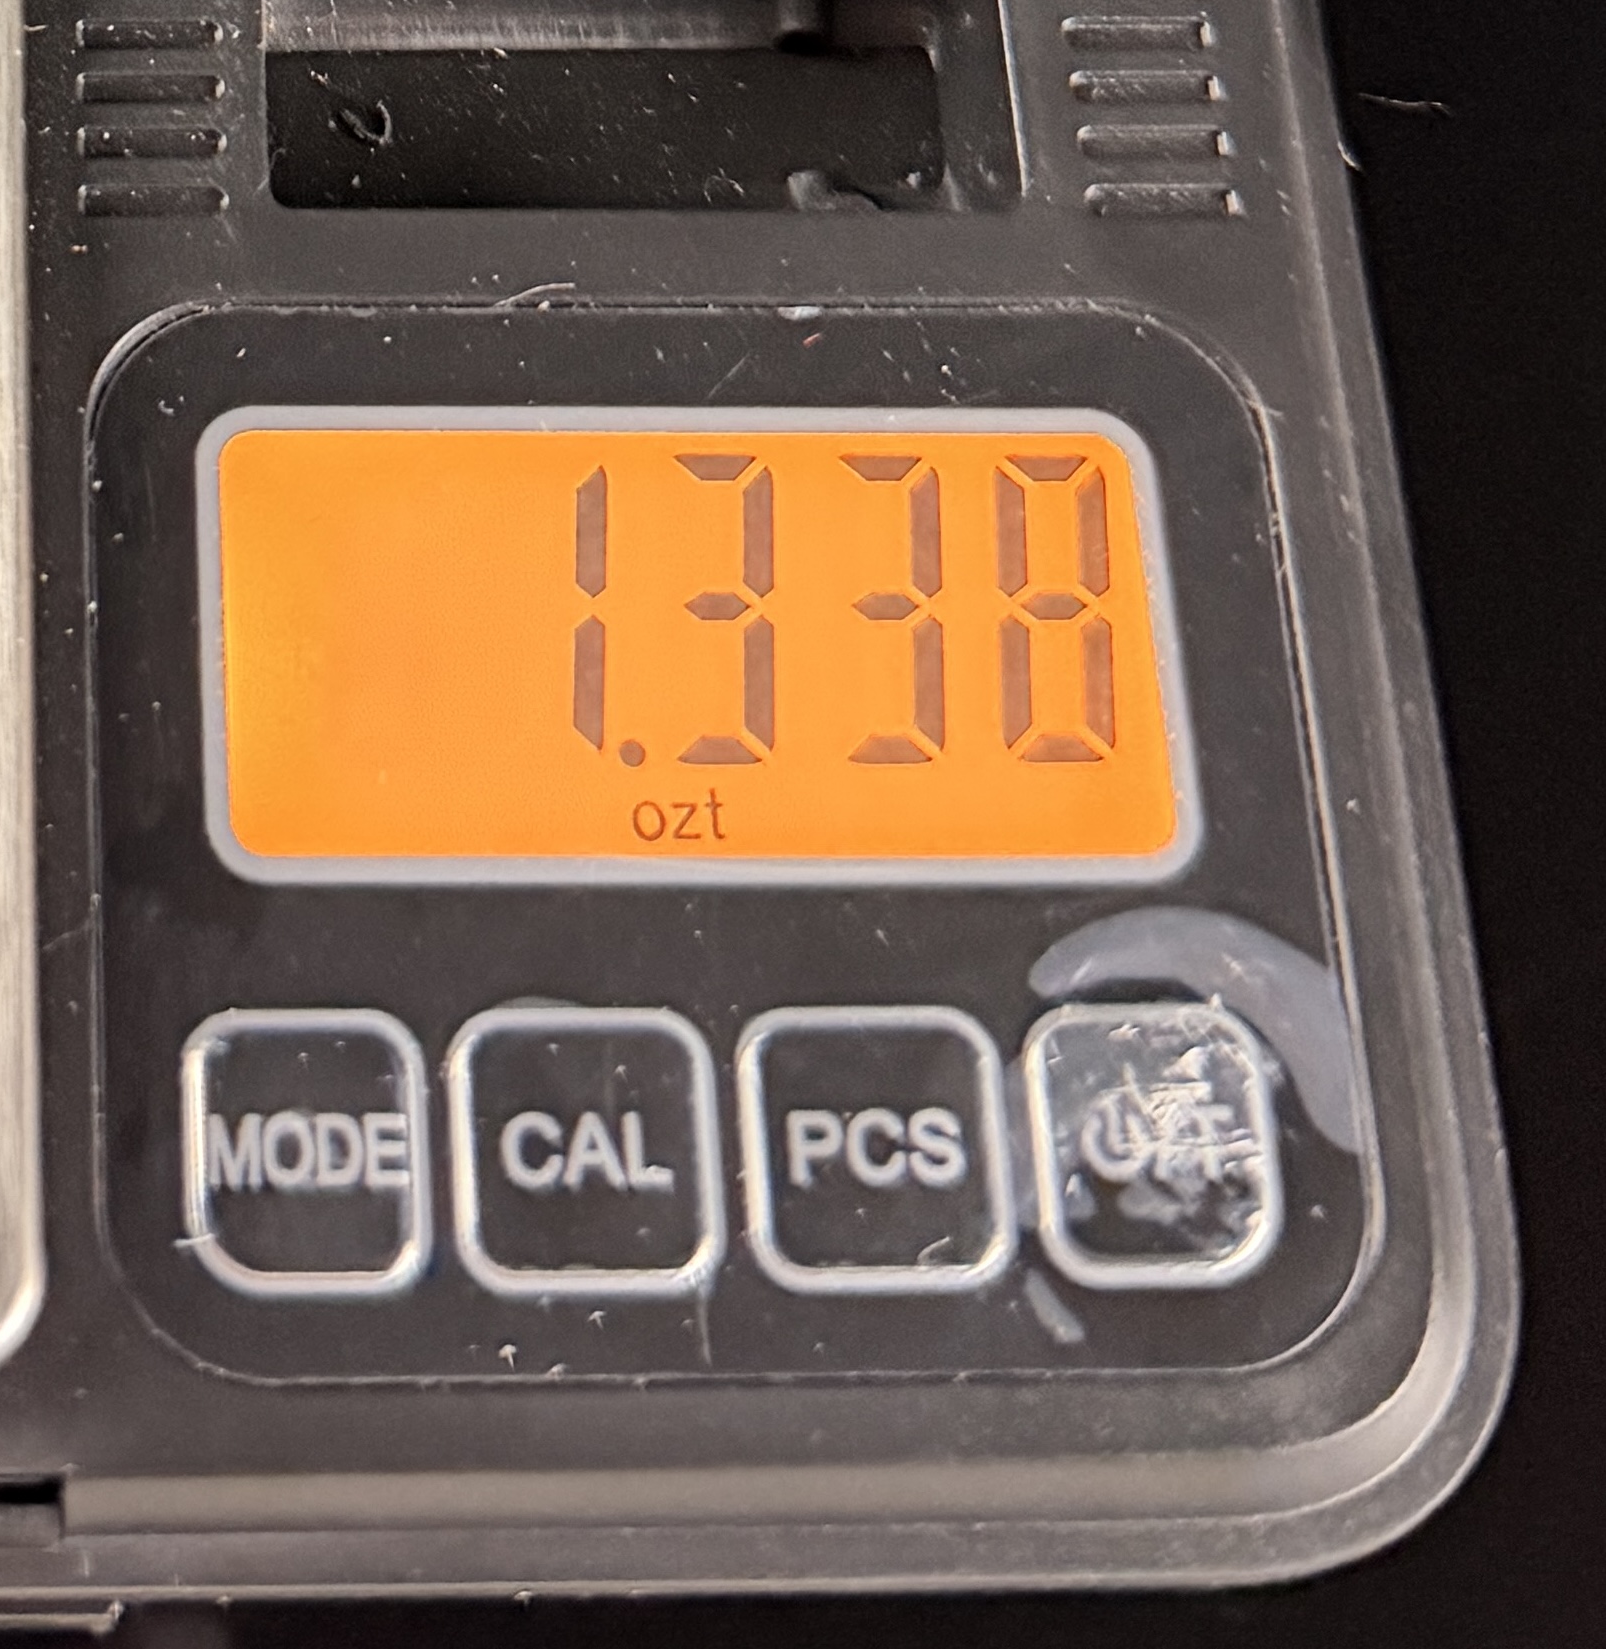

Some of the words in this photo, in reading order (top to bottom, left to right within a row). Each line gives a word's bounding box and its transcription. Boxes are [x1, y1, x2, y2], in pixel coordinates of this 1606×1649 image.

[573, 453, 1116, 765] 1.338
[631, 788, 728, 842] ozt
[208, 1112, 410, 1190] MODE
[500, 1111, 674, 1188] CAL
[787, 1107, 967, 1186] PCS
